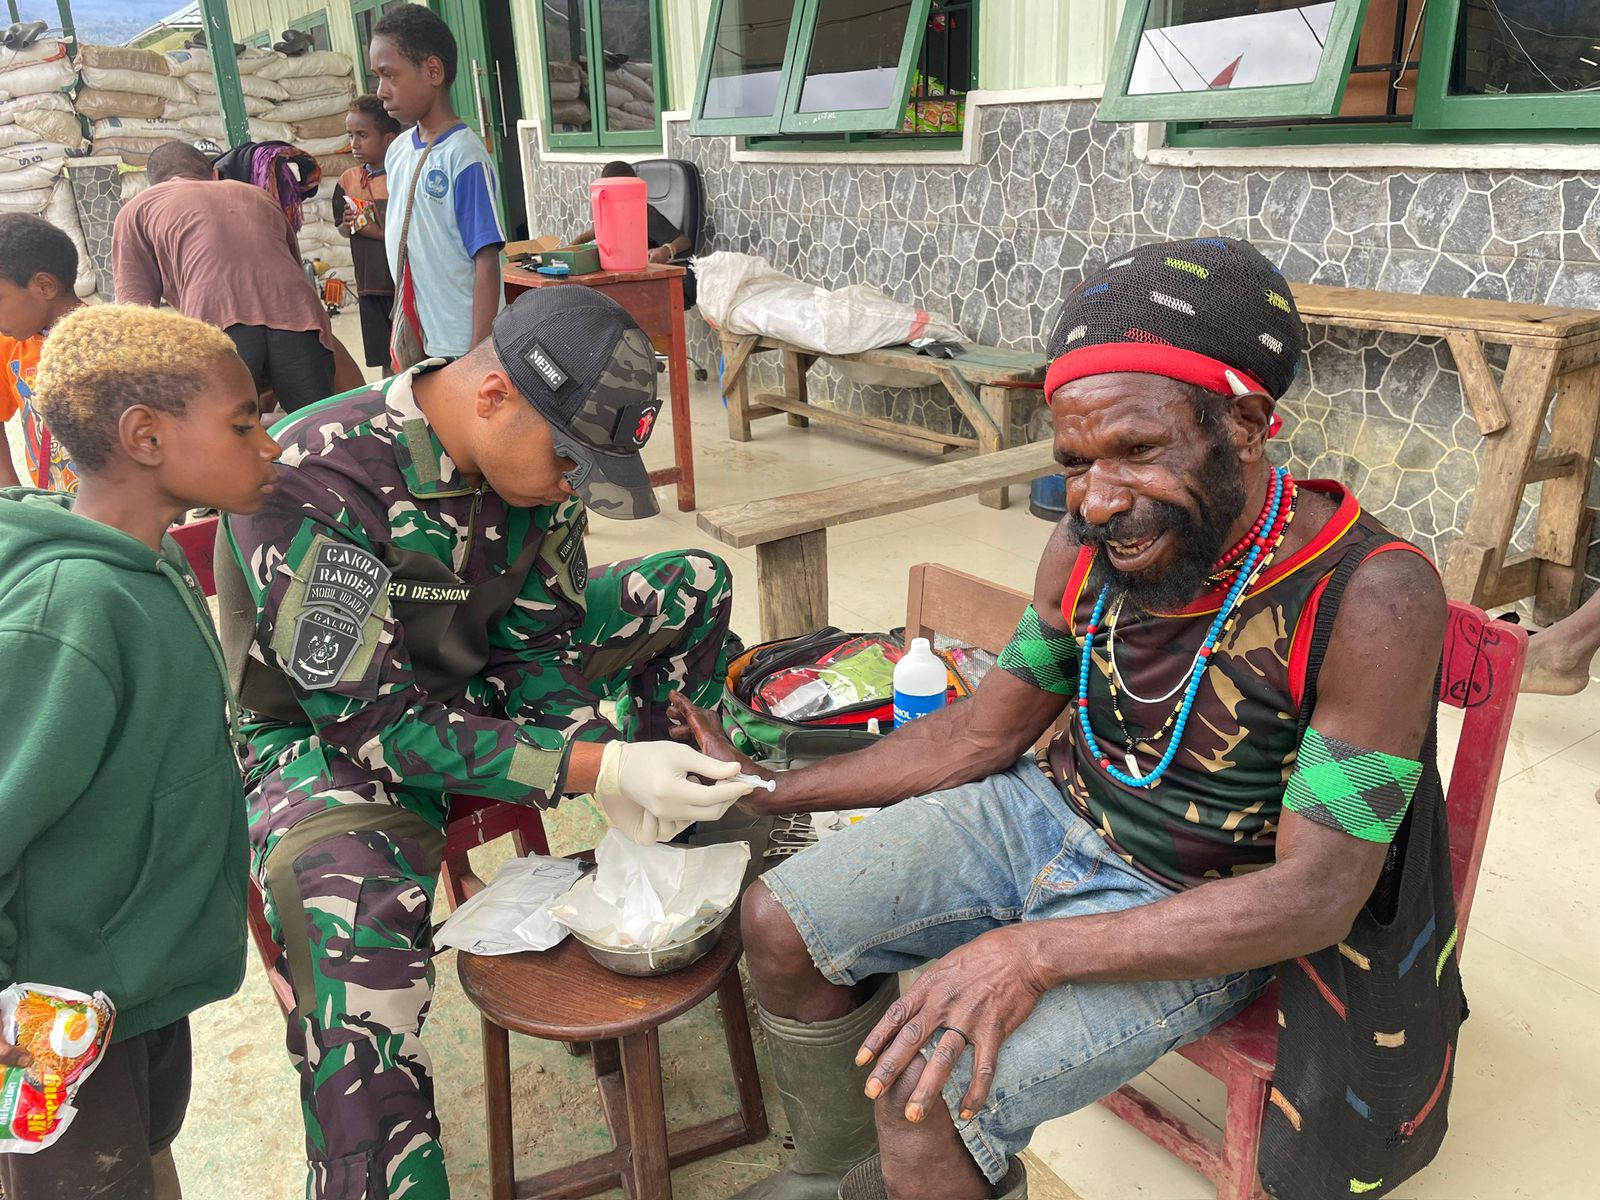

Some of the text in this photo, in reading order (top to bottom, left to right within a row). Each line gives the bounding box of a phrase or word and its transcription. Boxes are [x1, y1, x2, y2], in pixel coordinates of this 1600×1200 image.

[530, 350, 562, 385] MEDIC
[326, 548, 380, 580] CAKRA
[319, 568, 375, 598] RAIDER
[385, 582, 470, 601] EO DESMON
[311, 587, 367, 616] MOBIL UDARA
[314, 613, 355, 634] GALUH
[307, 673, 318, 682] 13
